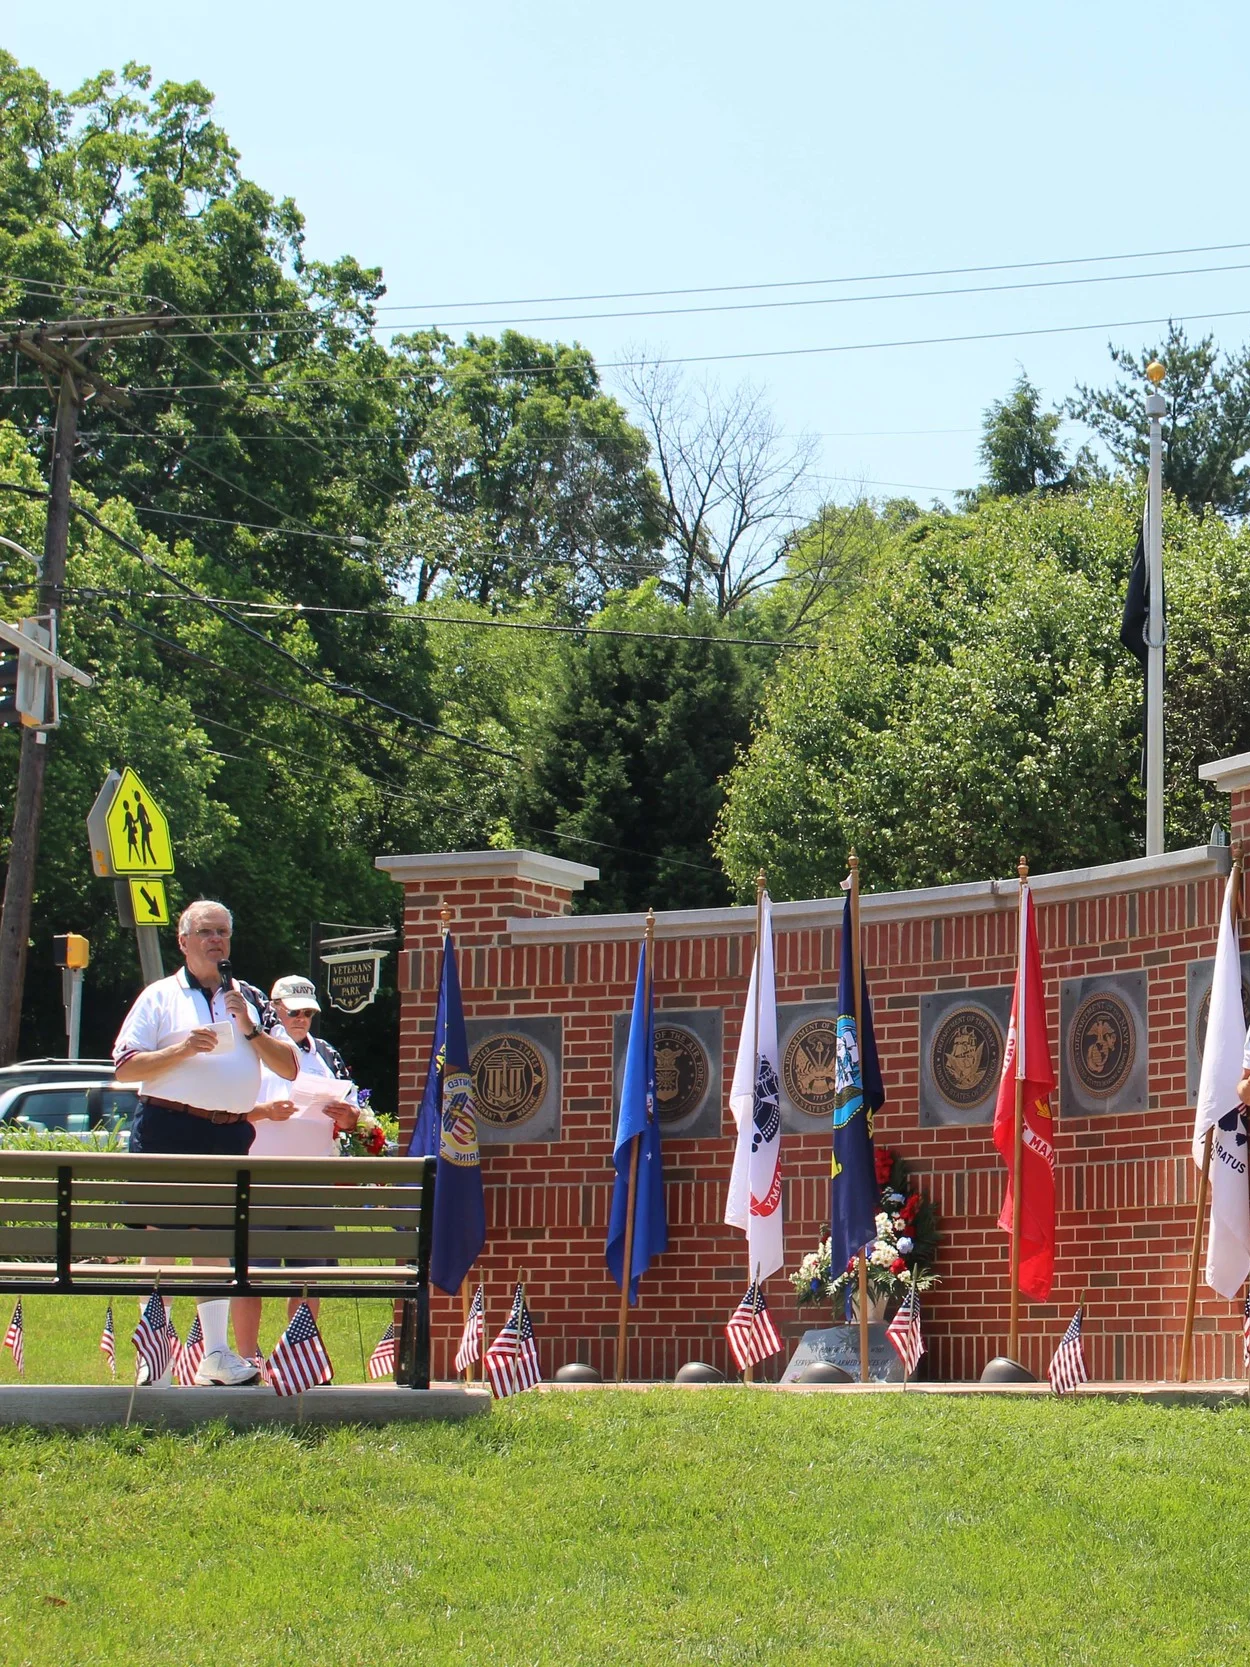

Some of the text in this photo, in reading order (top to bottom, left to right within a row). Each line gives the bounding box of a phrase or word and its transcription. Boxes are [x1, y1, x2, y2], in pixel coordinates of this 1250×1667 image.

[332, 974, 371, 986] MEMORIAL
[333, 962, 372, 975] VETERANS
[292, 986, 314, 995] NAVY
[341, 986, 360, 996] PARK
[785, 1022, 818, 1064] DEPARTMENT
[471, 1046, 490, 1071] UNITED
[518, 1043, 540, 1068] STATES
[655, 1031, 704, 1092] OF THE AIR FORCE
[784, 1072, 799, 1102] UNITED
[800, 1100, 826, 1113] STATES
[472, 1095, 498, 1120] ERCHANT
